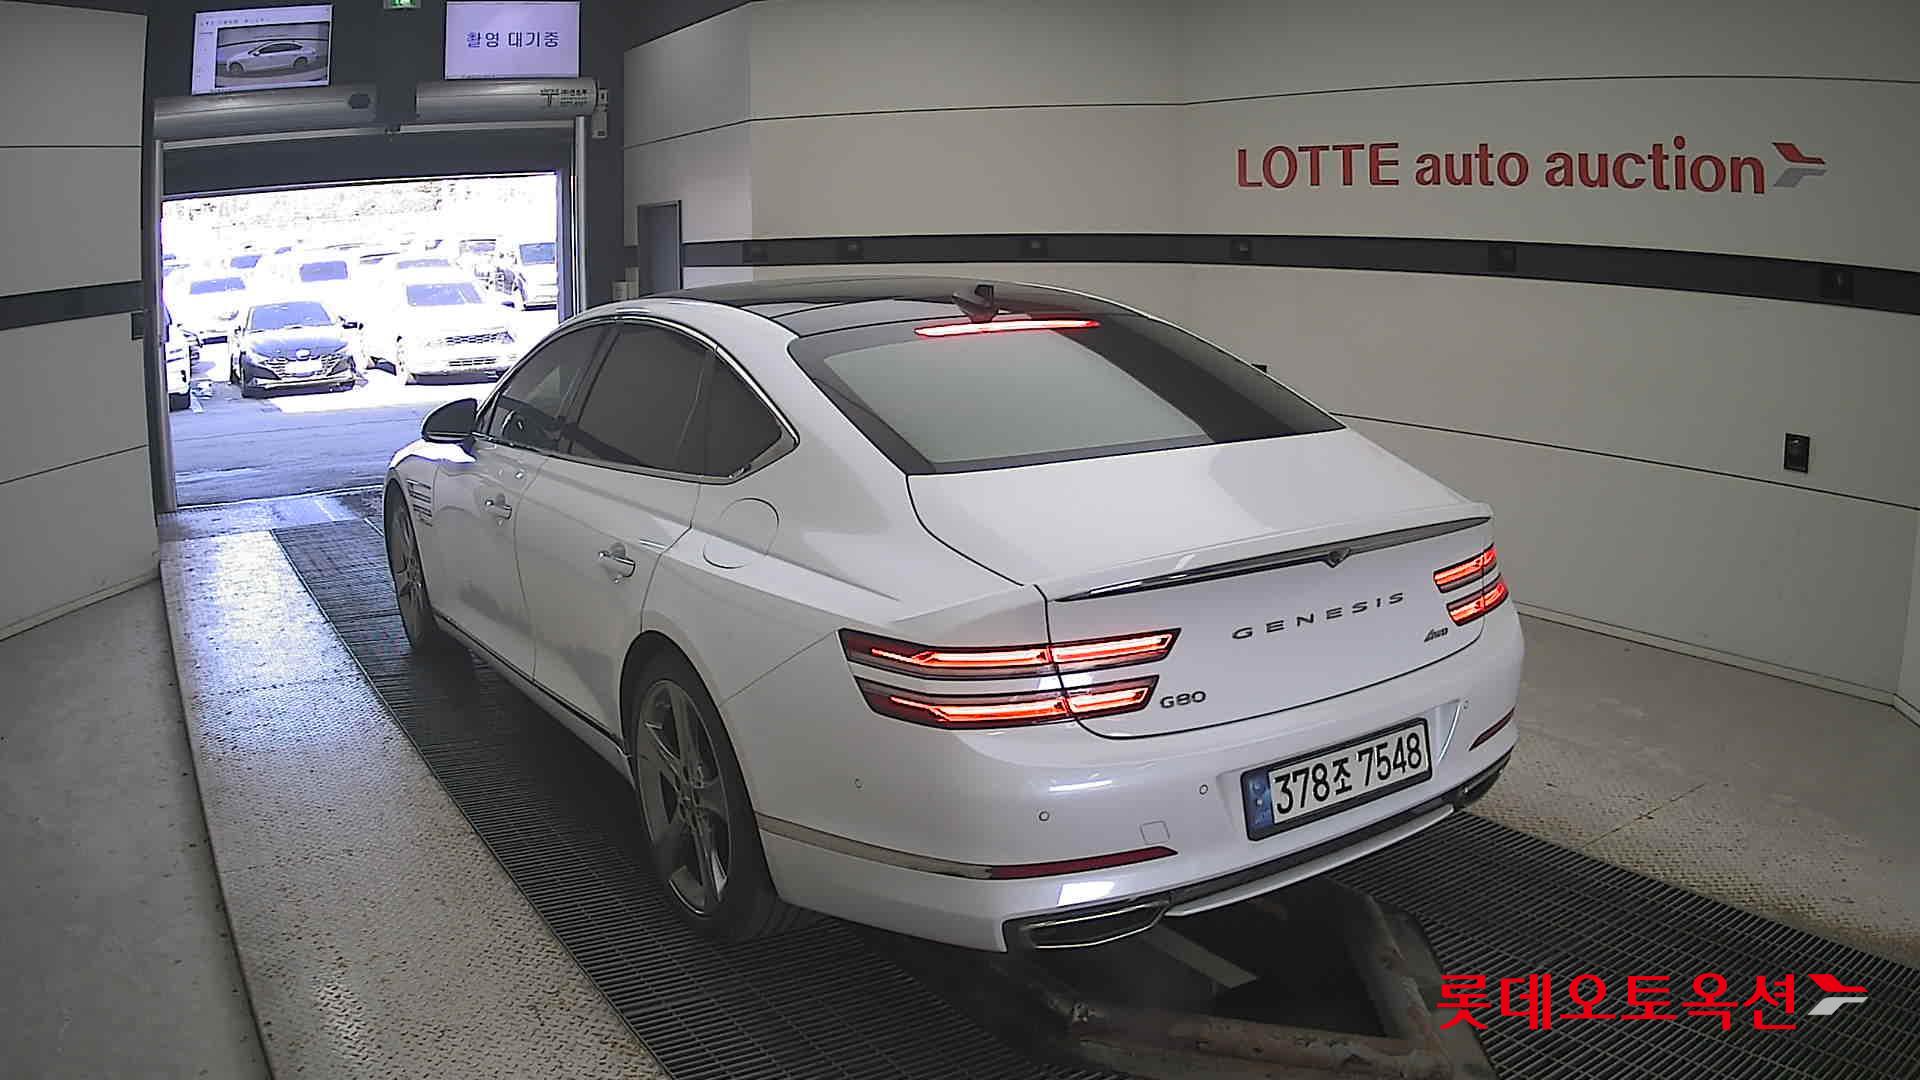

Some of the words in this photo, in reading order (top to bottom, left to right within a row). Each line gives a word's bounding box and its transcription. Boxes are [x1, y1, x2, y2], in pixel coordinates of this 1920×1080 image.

[466, 31, 499, 48] 촬영
[508, 31, 560, 48] 대기중
[1235, 142, 1400, 188] LOTTE
[1414, 142, 1529, 187] auto
[1544, 135, 1765, 195] auction
[1231, 592, 1405, 640] GENESIS
[1160, 690, 1207, 709] G80
[1274, 756, 1353, 815] 378조
[1357, 732, 1423, 787] 7548
